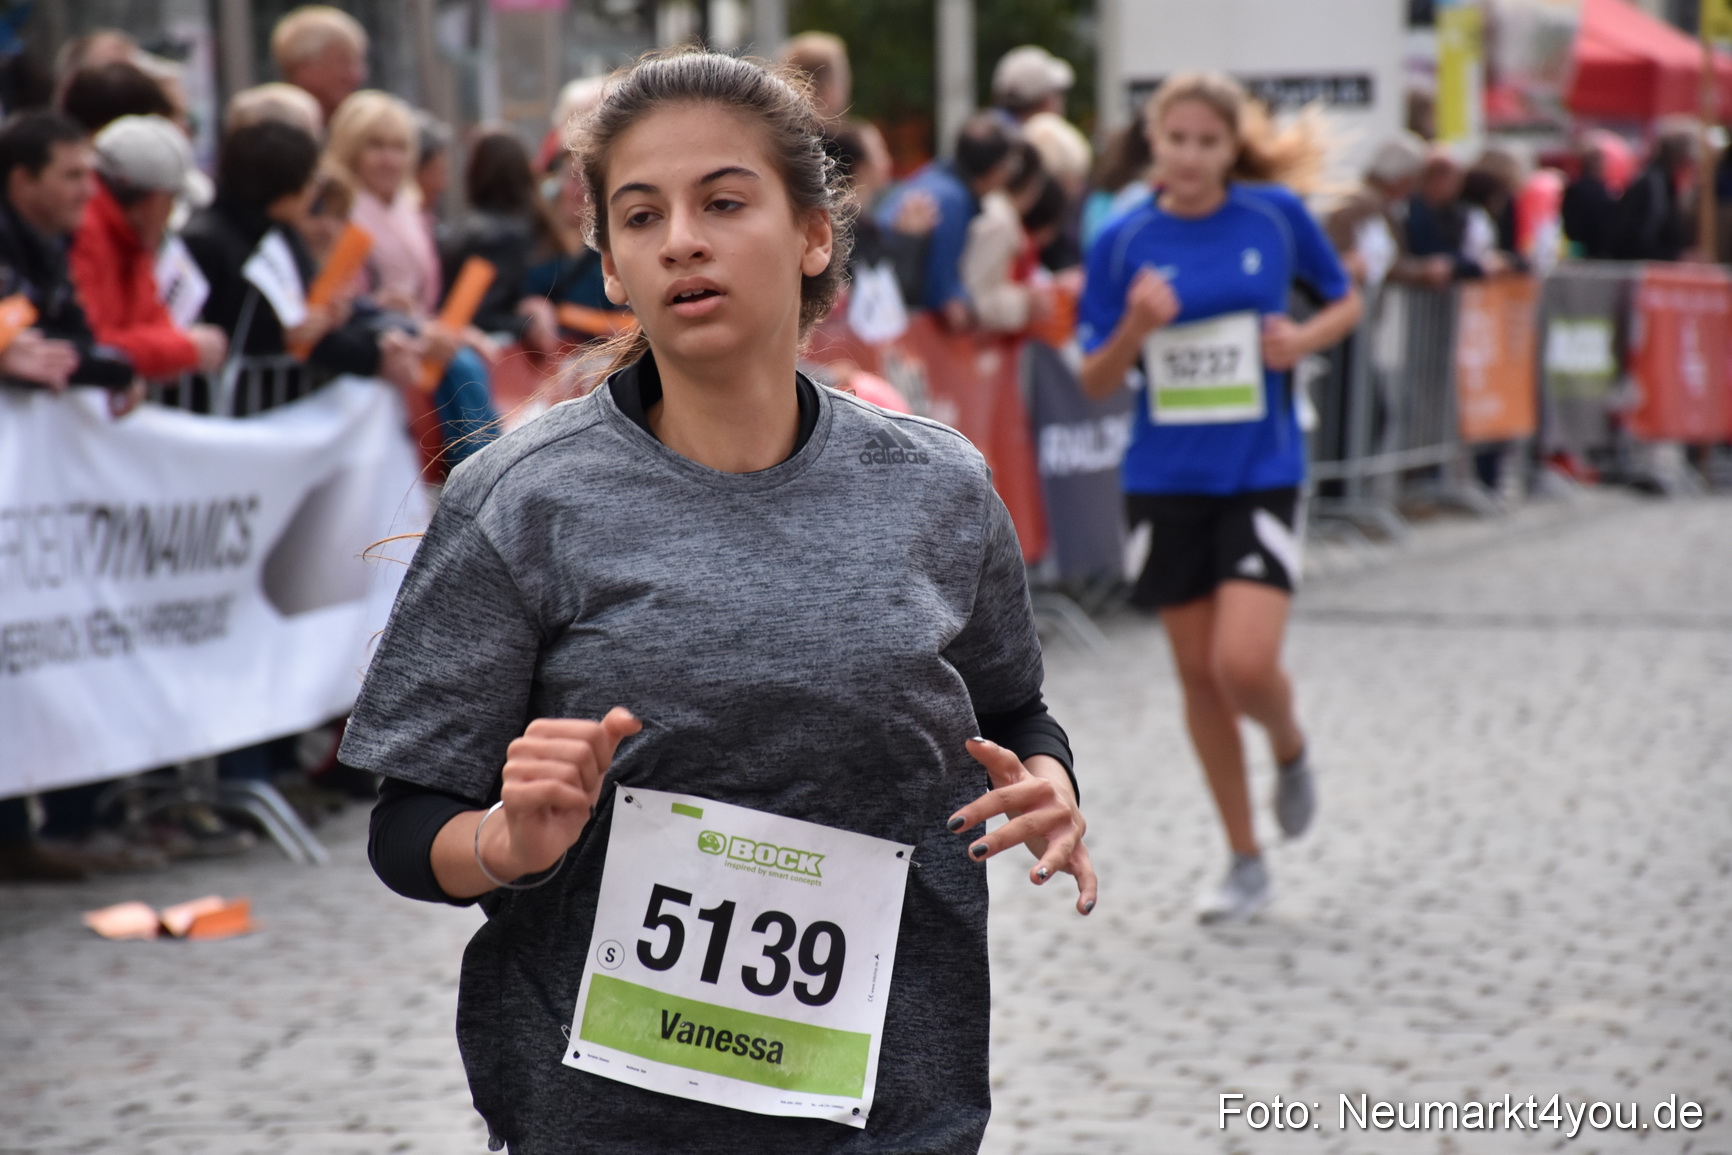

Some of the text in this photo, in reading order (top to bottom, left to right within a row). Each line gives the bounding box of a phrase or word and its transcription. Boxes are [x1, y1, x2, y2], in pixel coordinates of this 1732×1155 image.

[859, 447, 930, 465] adidas
[724, 860, 822, 887] inspired by smart concepts
[727, 835, 826, 878] BOCK
[605, 947, 617, 963] S
[636, 883, 847, 1007] 5139
[660, 1009, 785, 1065] Vanessa
